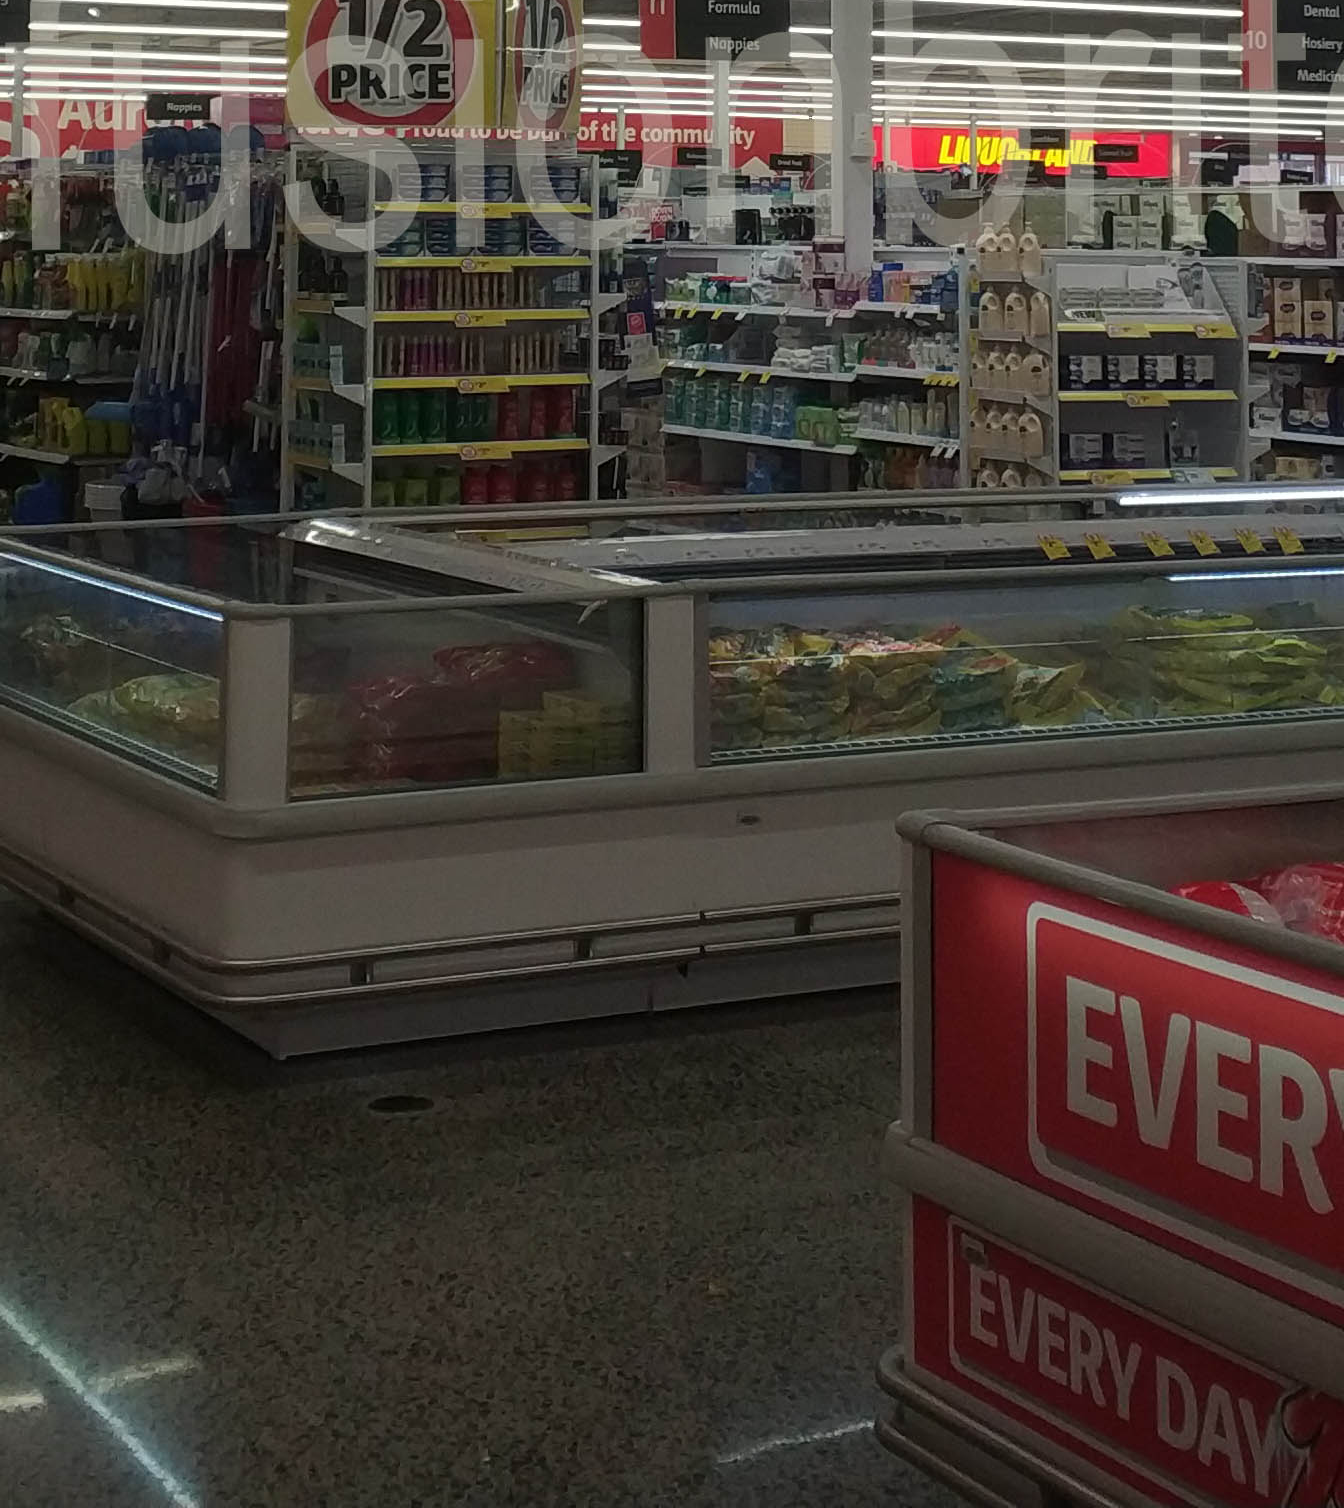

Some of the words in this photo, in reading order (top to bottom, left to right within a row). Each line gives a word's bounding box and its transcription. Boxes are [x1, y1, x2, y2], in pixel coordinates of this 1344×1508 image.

[707, 0, 761, 16] Formula
[1303, 4, 1341, 20] Dental
[709, 36, 761, 53] Nappies
[1245, 30, 1267, 50] 10
[1301, 36, 1344, 54] Hosiery
[330, 64, 452, 101] PRICE
[522, 65, 569, 106] PRICE
[166, 102, 203, 113] Nappies
[577, 120, 598, 142] of
[641, 123, 756, 150] commuity
[967, 1264, 1144, 1423] EVERY
[1155, 1356, 1282, 1497] DAY
